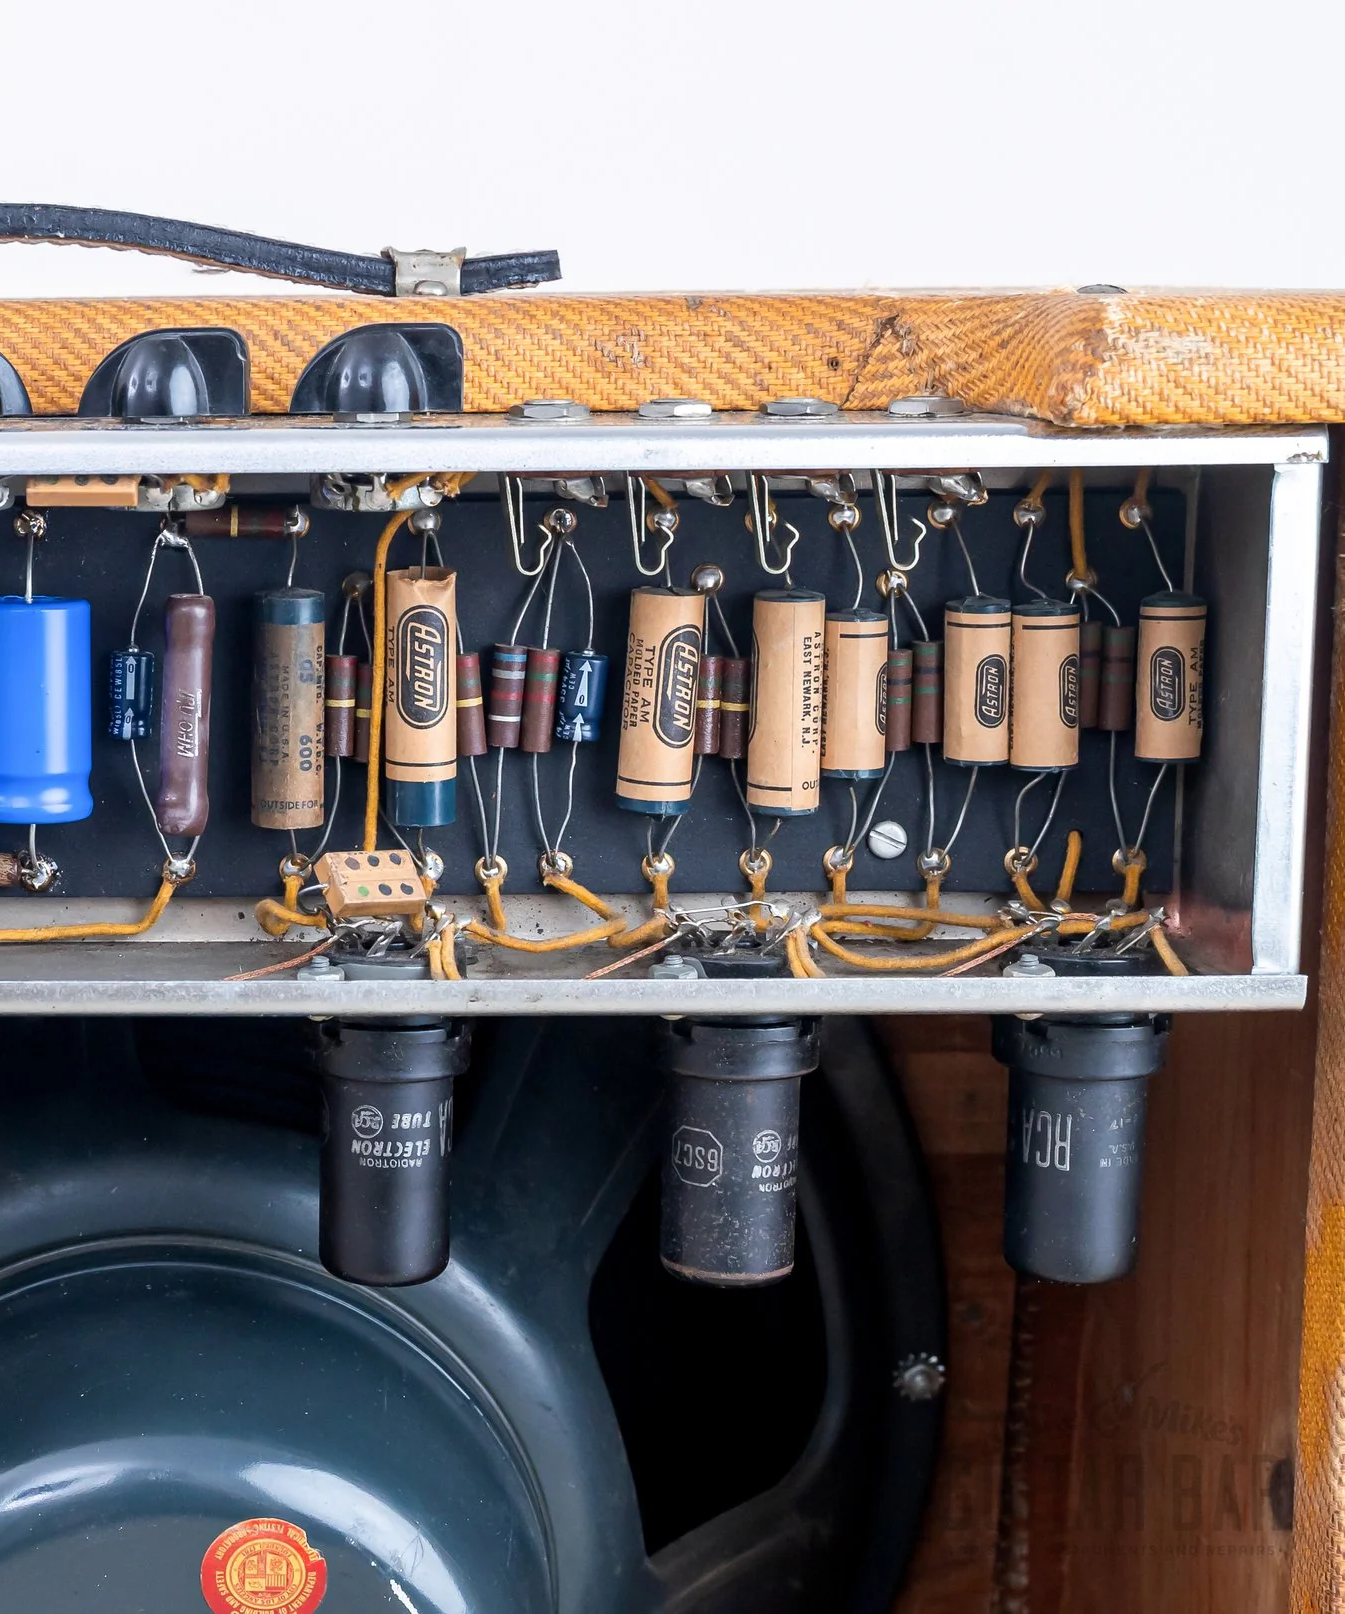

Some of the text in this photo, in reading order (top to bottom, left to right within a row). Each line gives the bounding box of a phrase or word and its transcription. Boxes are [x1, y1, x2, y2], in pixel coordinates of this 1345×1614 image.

[282, 665, 290, 700] MADE
[406, 622, 441, 711] ASTRON
[622, 632, 635, 731] CAPACITOR
[629, 639, 644, 728] MOLDED PAPER
[640, 646, 656, 722] TYPE AM
[667, 642, 698, 730] ASTRON
[813, 632, 822, 694] ASTRON
[1156, 658, 1178, 710] ASTRON
[1189, 647, 1198, 725] TYPE AM
[282, 706, 289, 719] IN
[388, 678, 394, 703] AM
[801, 637, 812, 748] EAST NEWARK, N.J.
[981, 666, 1002, 718] ASTRON
[1065, 665, 1076, 716] ASTRON
[299, 734, 313, 772] 600
[261, 800, 299, 809] OUTSIDE
[391, 1110, 431, 1129] TUBE
[1022, 1108, 1072, 1171] RCA
[351, 1139, 430, 1157] ELECTRON
[359, 1157, 423, 1168] RADIOTRON
[674, 1140, 718, 1172] 6SC7
[225, 1594, 240, 1608] AND
